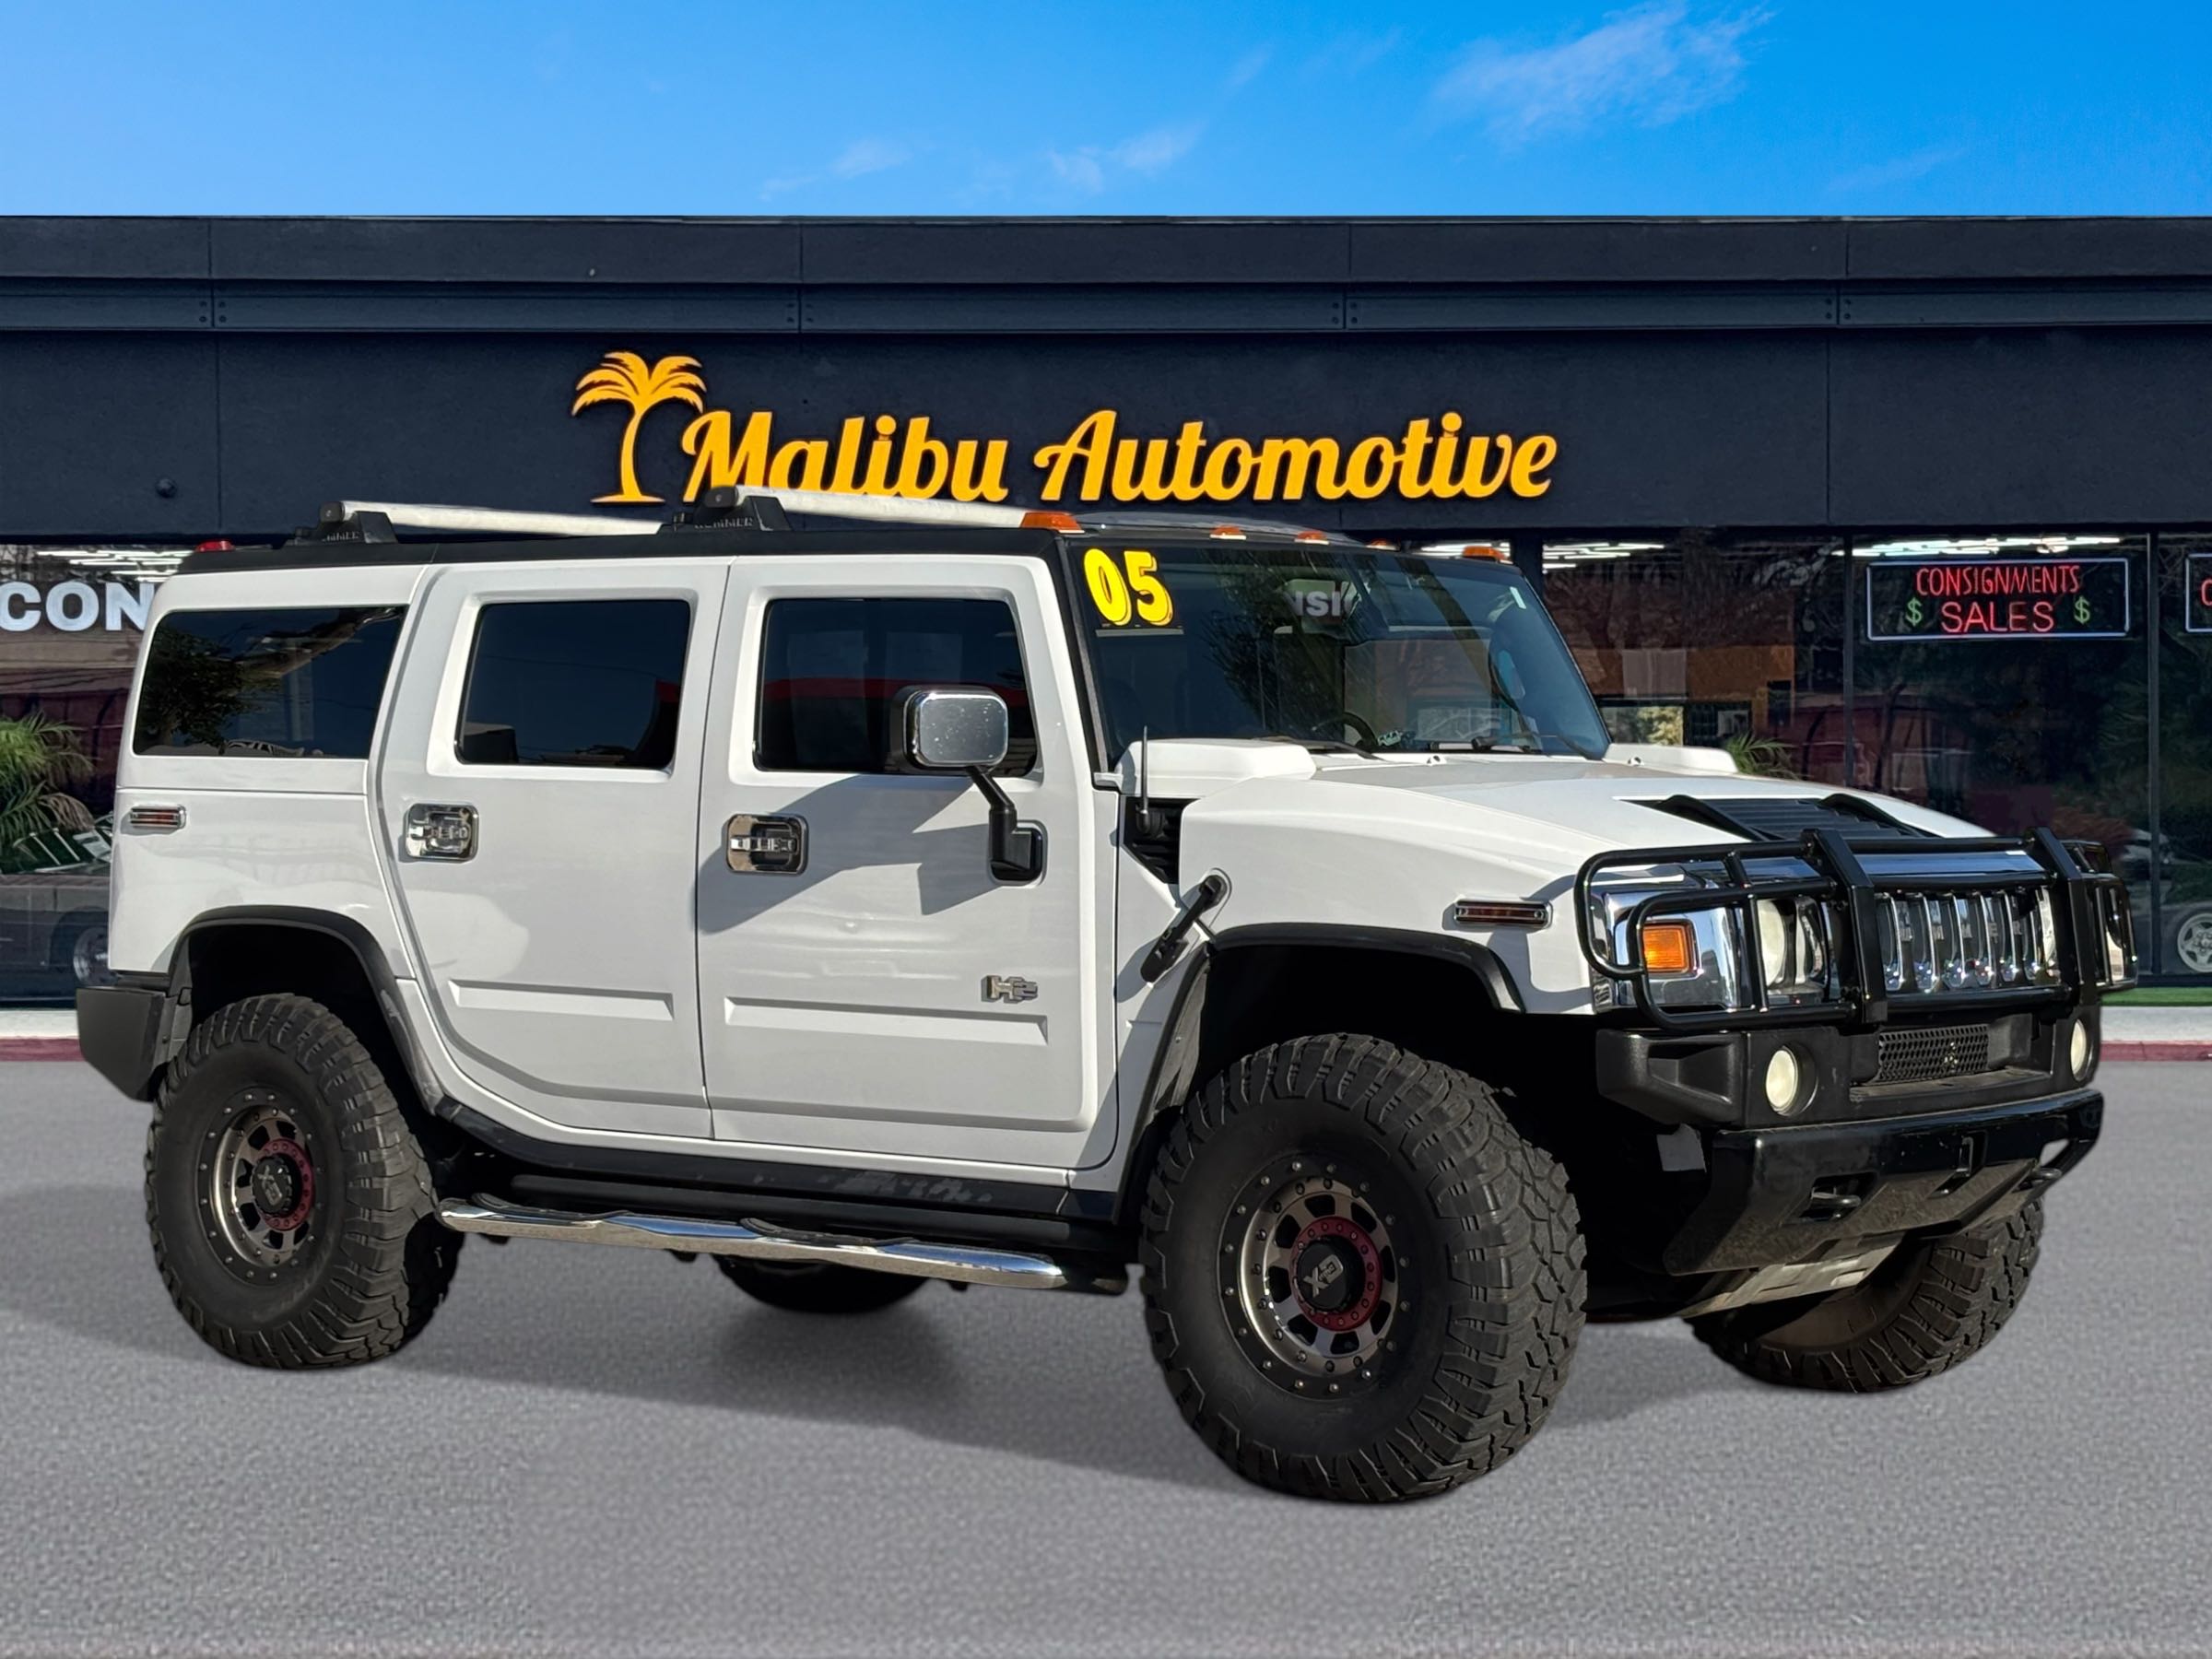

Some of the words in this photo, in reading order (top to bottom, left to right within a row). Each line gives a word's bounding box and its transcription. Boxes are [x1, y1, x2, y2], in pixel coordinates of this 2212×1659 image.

[681, 410, 1008, 503] Malibu
[1033, 409, 1558, 501] Automotive
[1084, 548, 1173, 626] 05
[1915, 565, 2080, 596] CONSIGNMENTS
[0, 582, 155, 631] CON
[1941, 601, 2055, 632] SALES
[981, 975, 1038, 1004] H2
